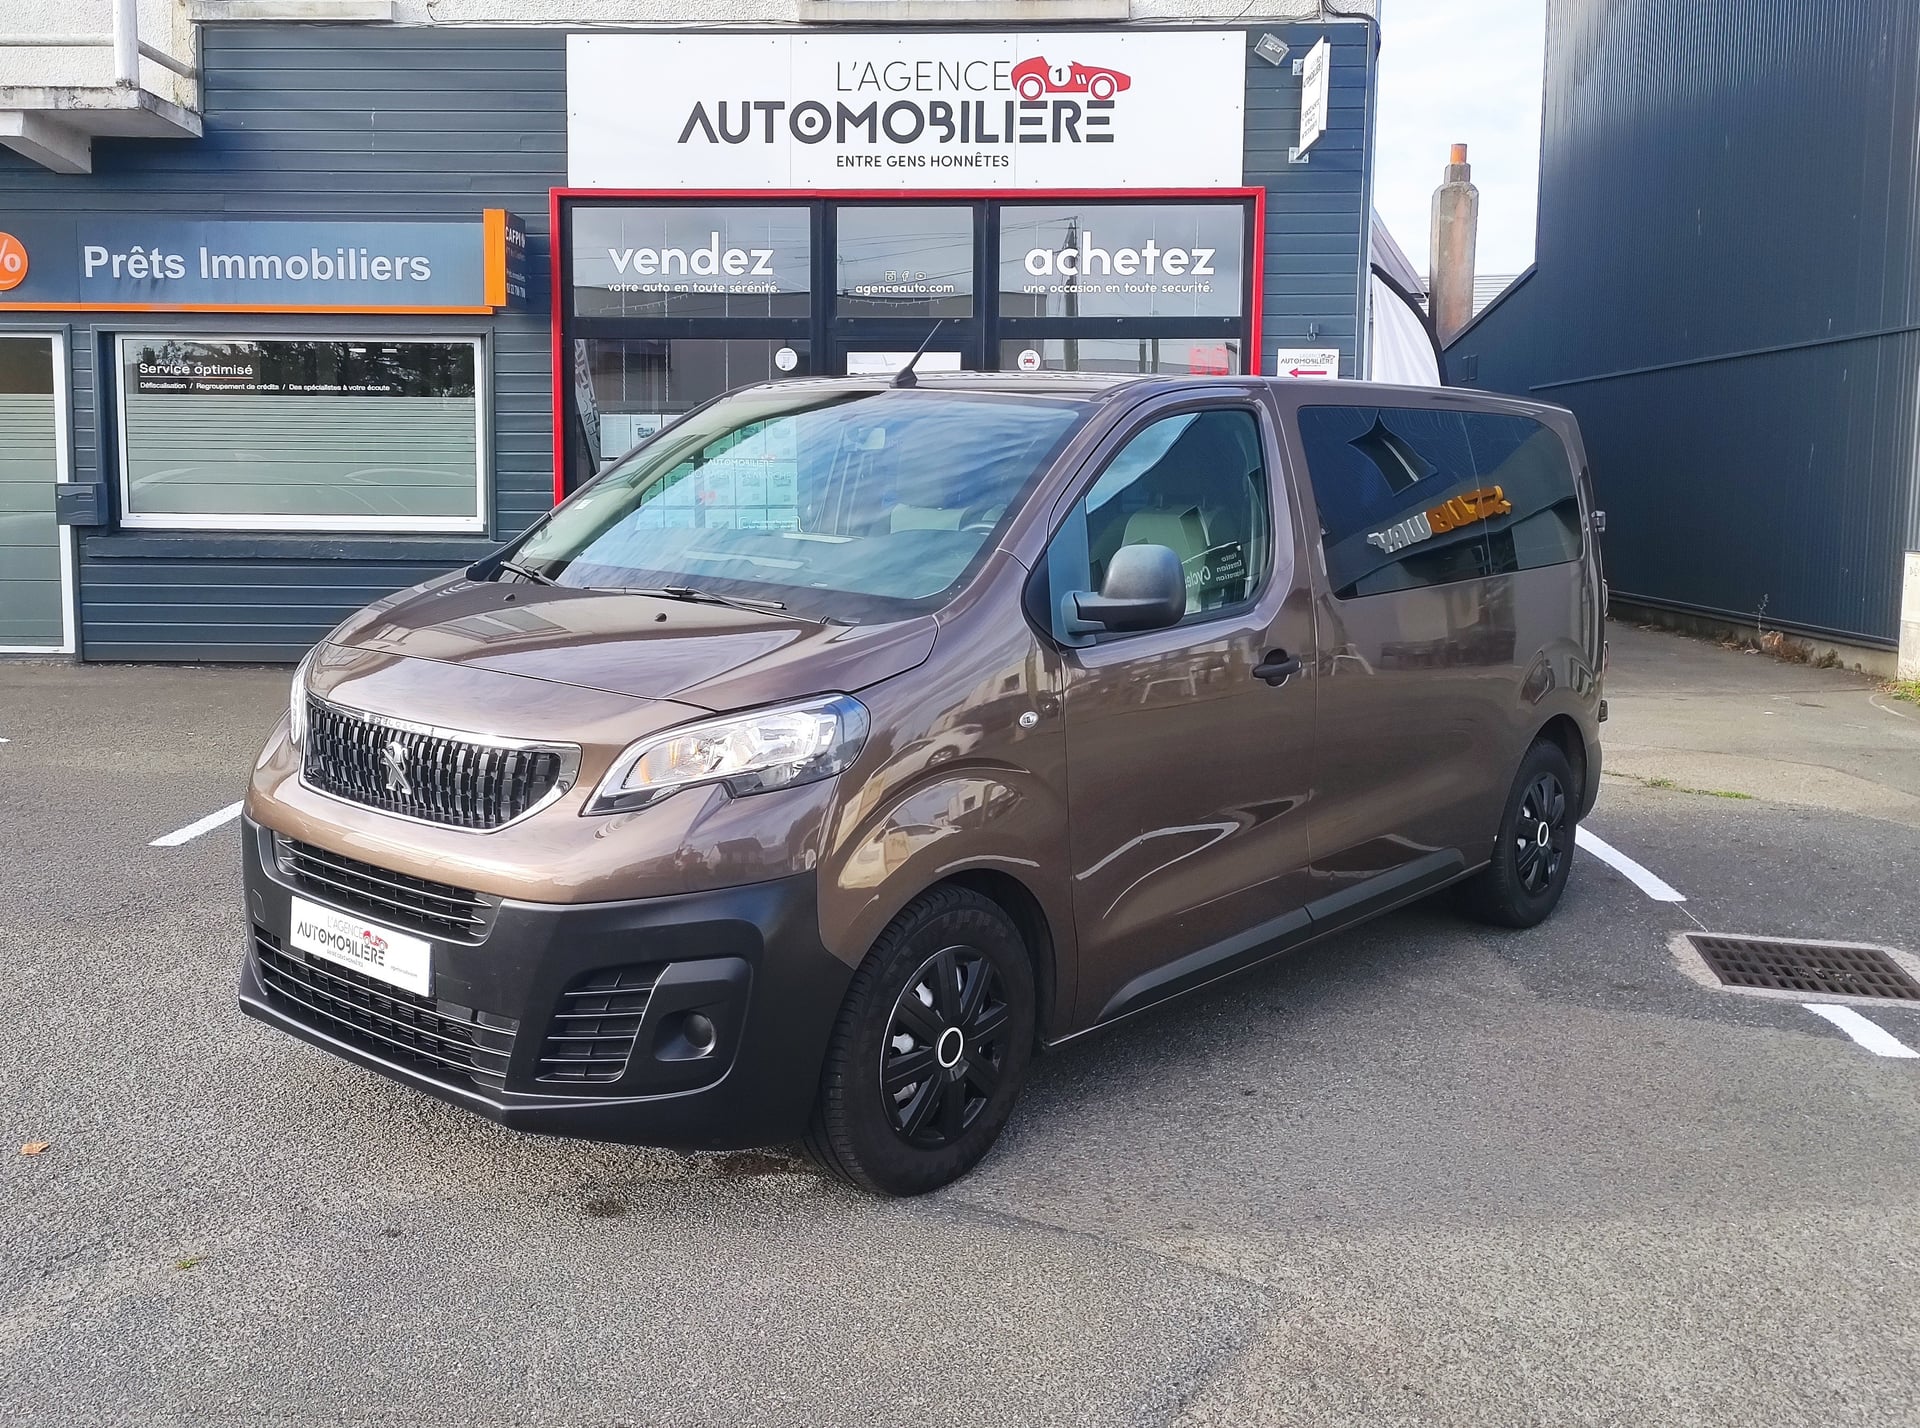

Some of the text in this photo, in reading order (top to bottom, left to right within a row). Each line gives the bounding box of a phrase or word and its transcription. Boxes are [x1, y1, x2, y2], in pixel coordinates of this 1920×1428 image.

[836, 61, 1011, 92] L'AGENCE
[1055, 68, 1063, 82] 1
[836, 152, 1009, 168] ENTRE GENS HONNÊTES
[607, 231, 775, 276] vendez
[1024, 231, 1216, 276] achetez
[83, 246, 432, 281] Prêts Immobiliers
[607, 281, 781, 293] votre auto en toute sérénité.
[855, 283, 954, 296] agenceauto.com
[1023, 280, 1213, 294] une occasion en toute securité.
[139, 363, 253, 377] Service optimisé
[196, 382, 245, 391] Regroupement
[303, 383, 342, 392] spécialistes
[366, 384, 391, 392] écoute
